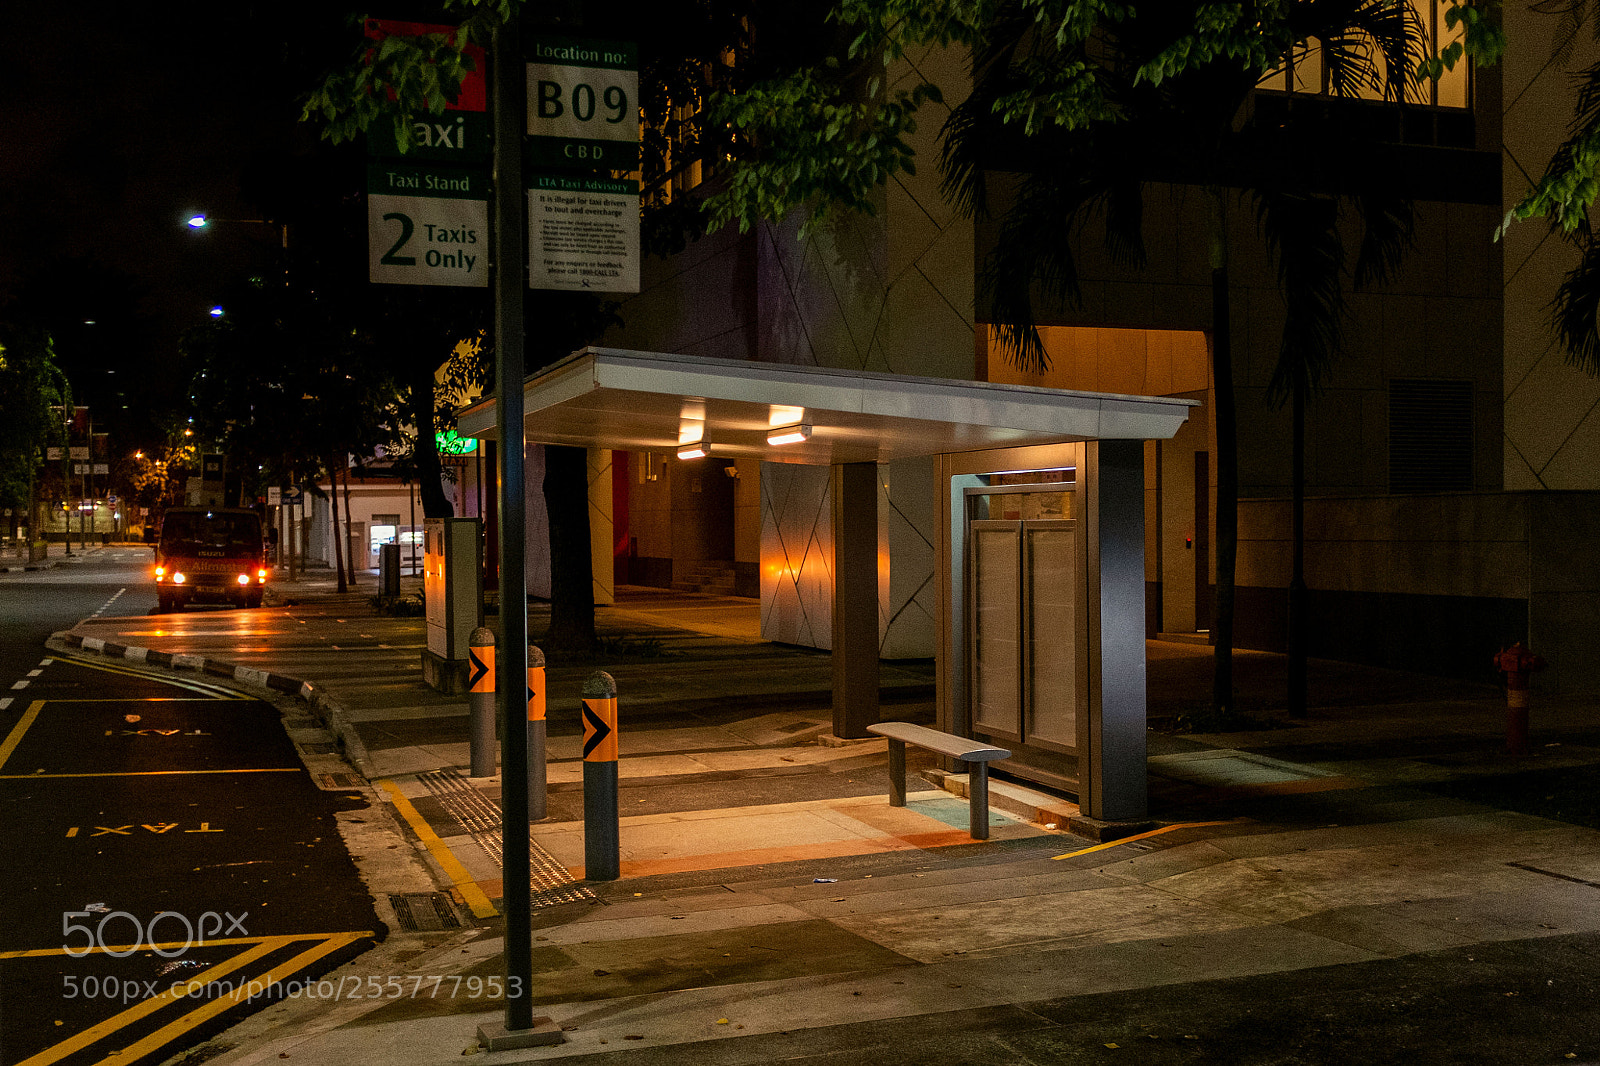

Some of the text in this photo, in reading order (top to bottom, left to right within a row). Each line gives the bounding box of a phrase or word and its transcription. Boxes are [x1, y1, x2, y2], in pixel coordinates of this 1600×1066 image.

[536, 43, 627, 64] Location no:
[537, 80, 628, 124] B09
[405, 116, 465, 149] axi
[385, 172, 470, 191] Taxi Stand
[539, 177, 628, 193] LTA Taxi Advisory
[555, 196, 576, 205] illegal
[604, 199, 627, 207] drivers
[585, 209, 622, 218] overcharge
[381, 212, 477, 266] 2 Taxis
[425, 249, 476, 273] Only
[65, 822, 224, 838] TAXI
